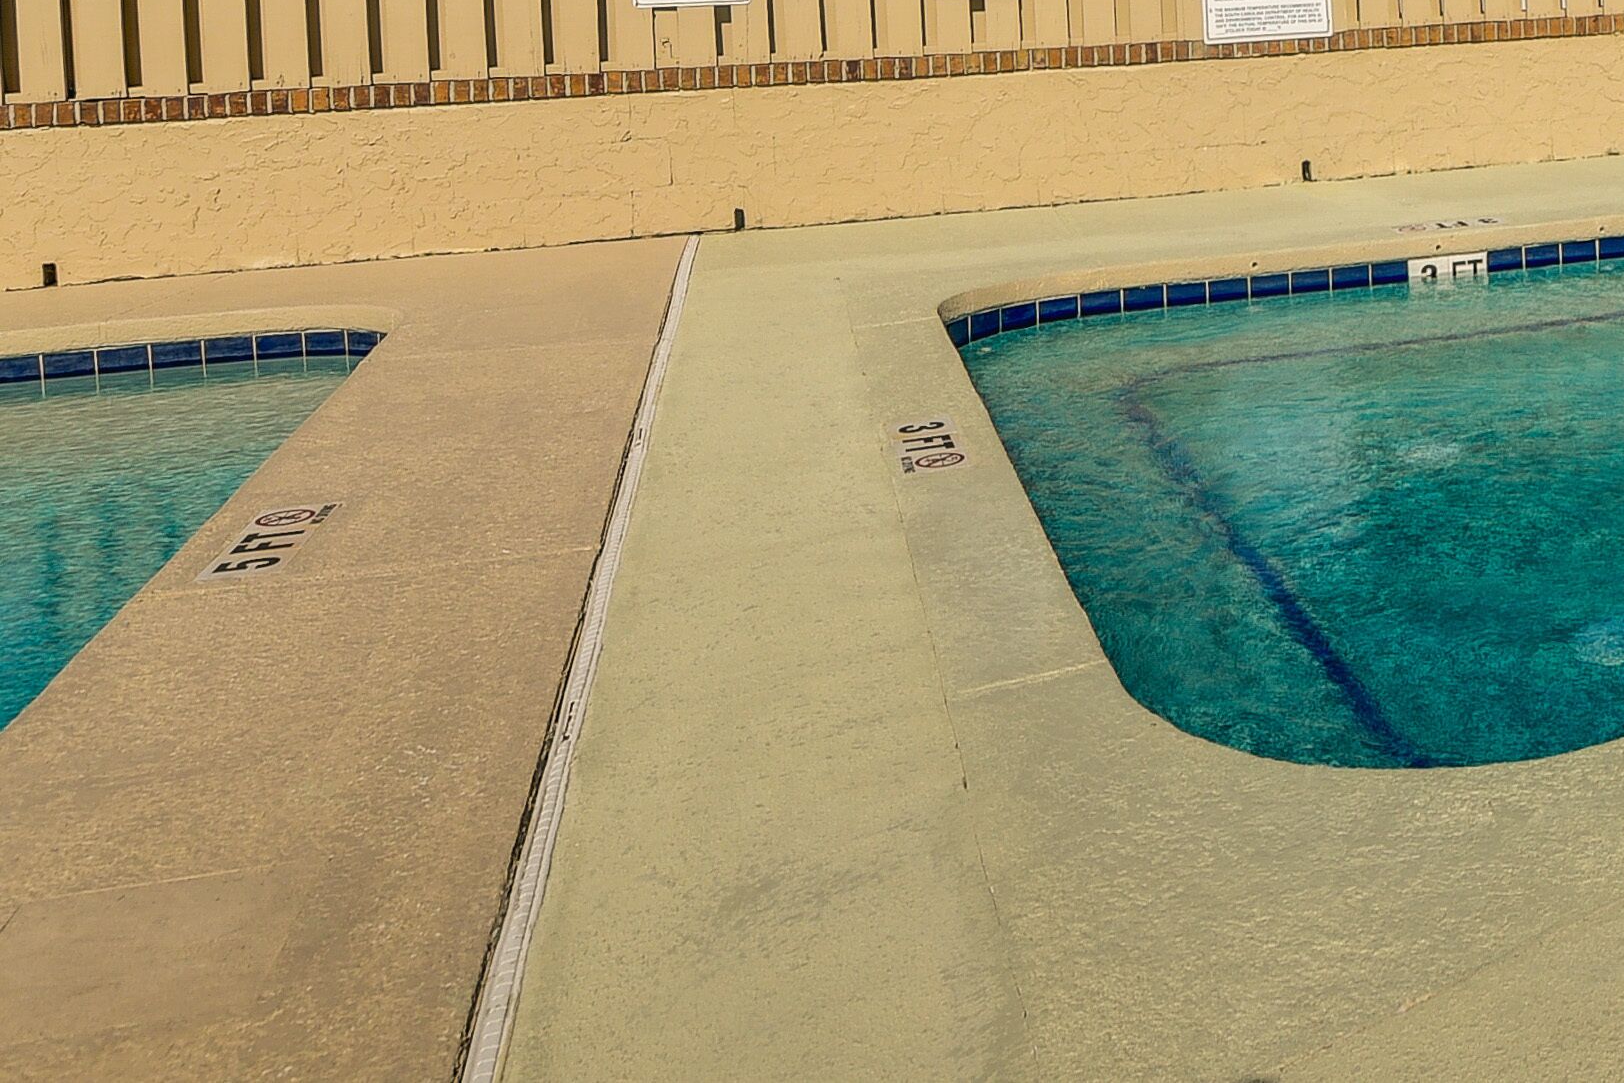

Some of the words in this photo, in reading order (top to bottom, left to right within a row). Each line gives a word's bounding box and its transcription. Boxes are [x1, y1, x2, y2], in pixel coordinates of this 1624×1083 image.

[898, 421, 944, 433] 3
[902, 435, 956, 452] FT
[229, 529, 305, 555] FT
[212, 557, 280, 573] 5
